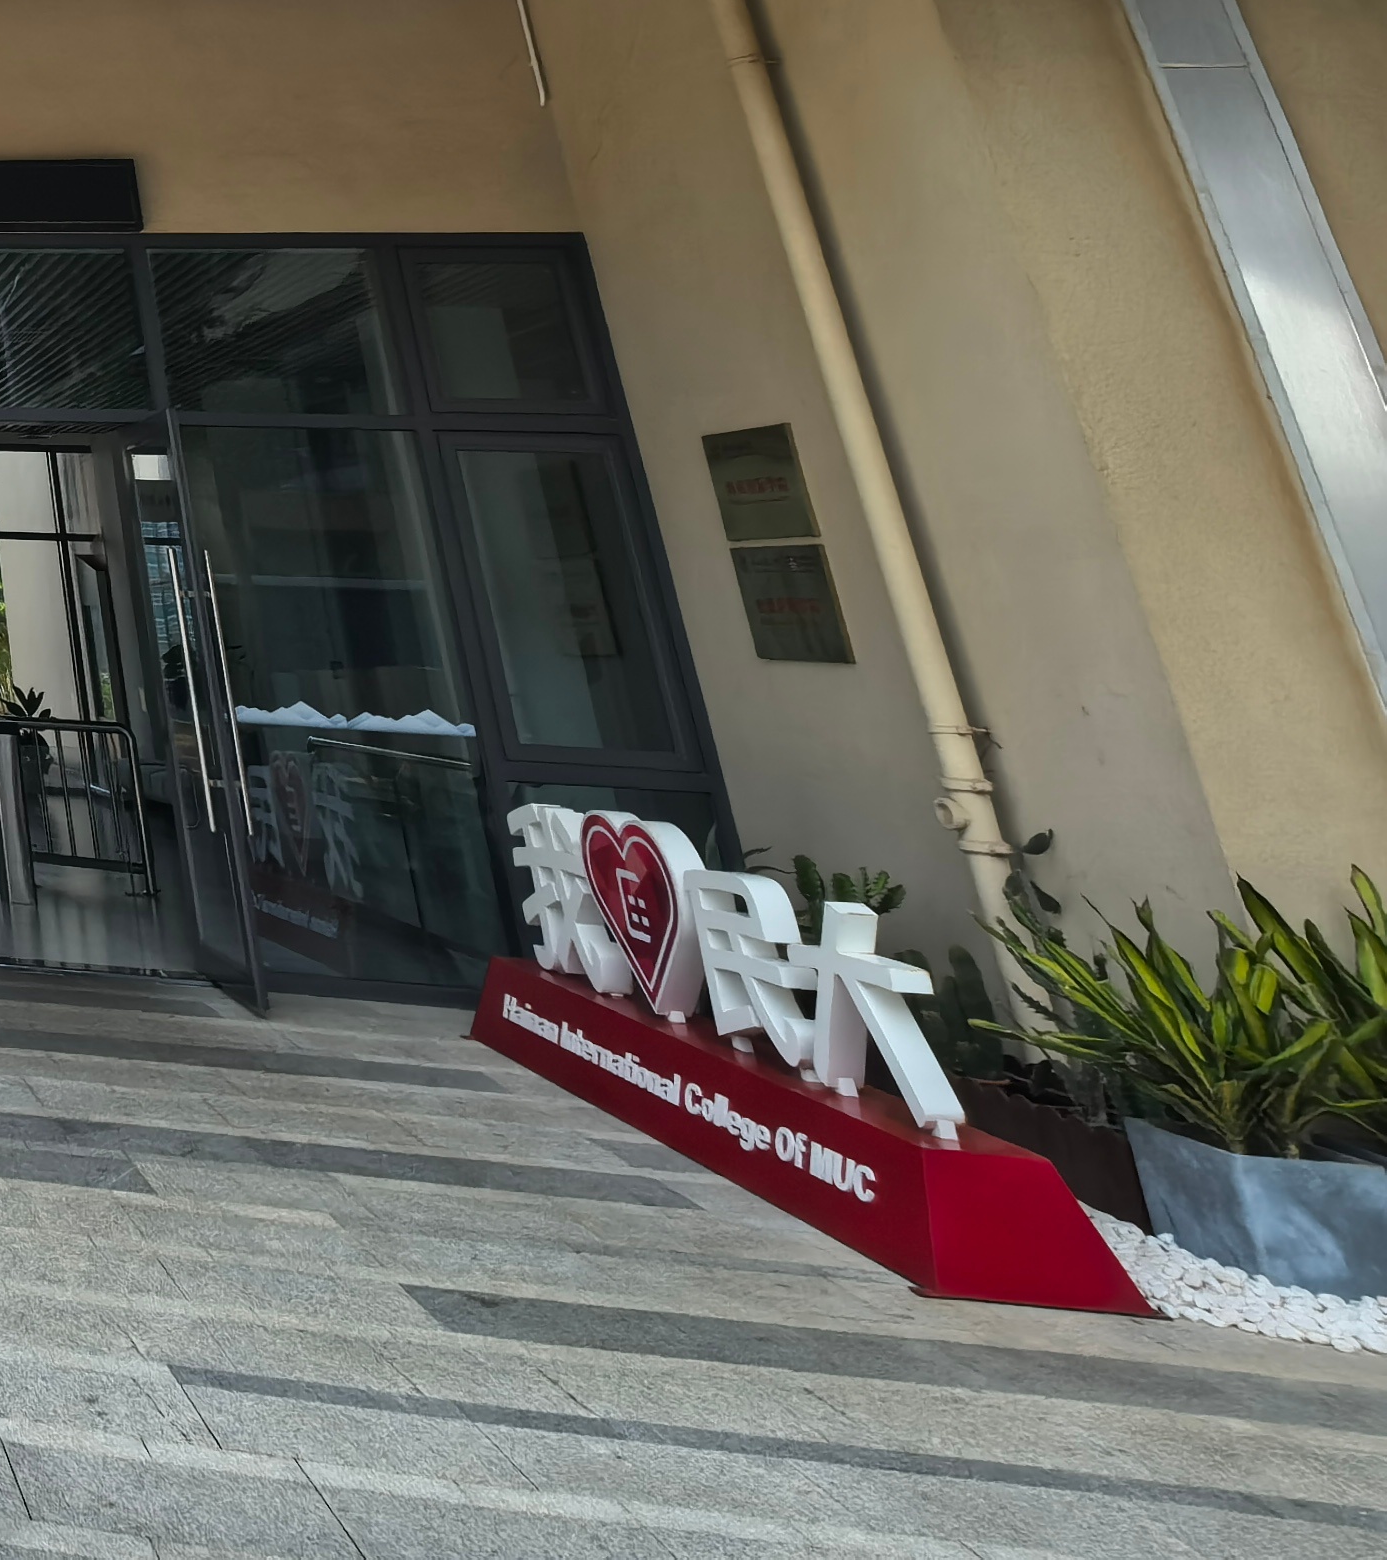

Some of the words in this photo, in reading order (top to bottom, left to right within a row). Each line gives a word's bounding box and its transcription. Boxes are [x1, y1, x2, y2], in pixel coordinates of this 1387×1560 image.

[502, 993, 560, 1045] Hainan
[557, 1021, 681, 1107] International
[684, 1082, 771, 1152] College
[775, 1127, 807, 1170] Of
[809, 1140, 877, 1203] MUC
